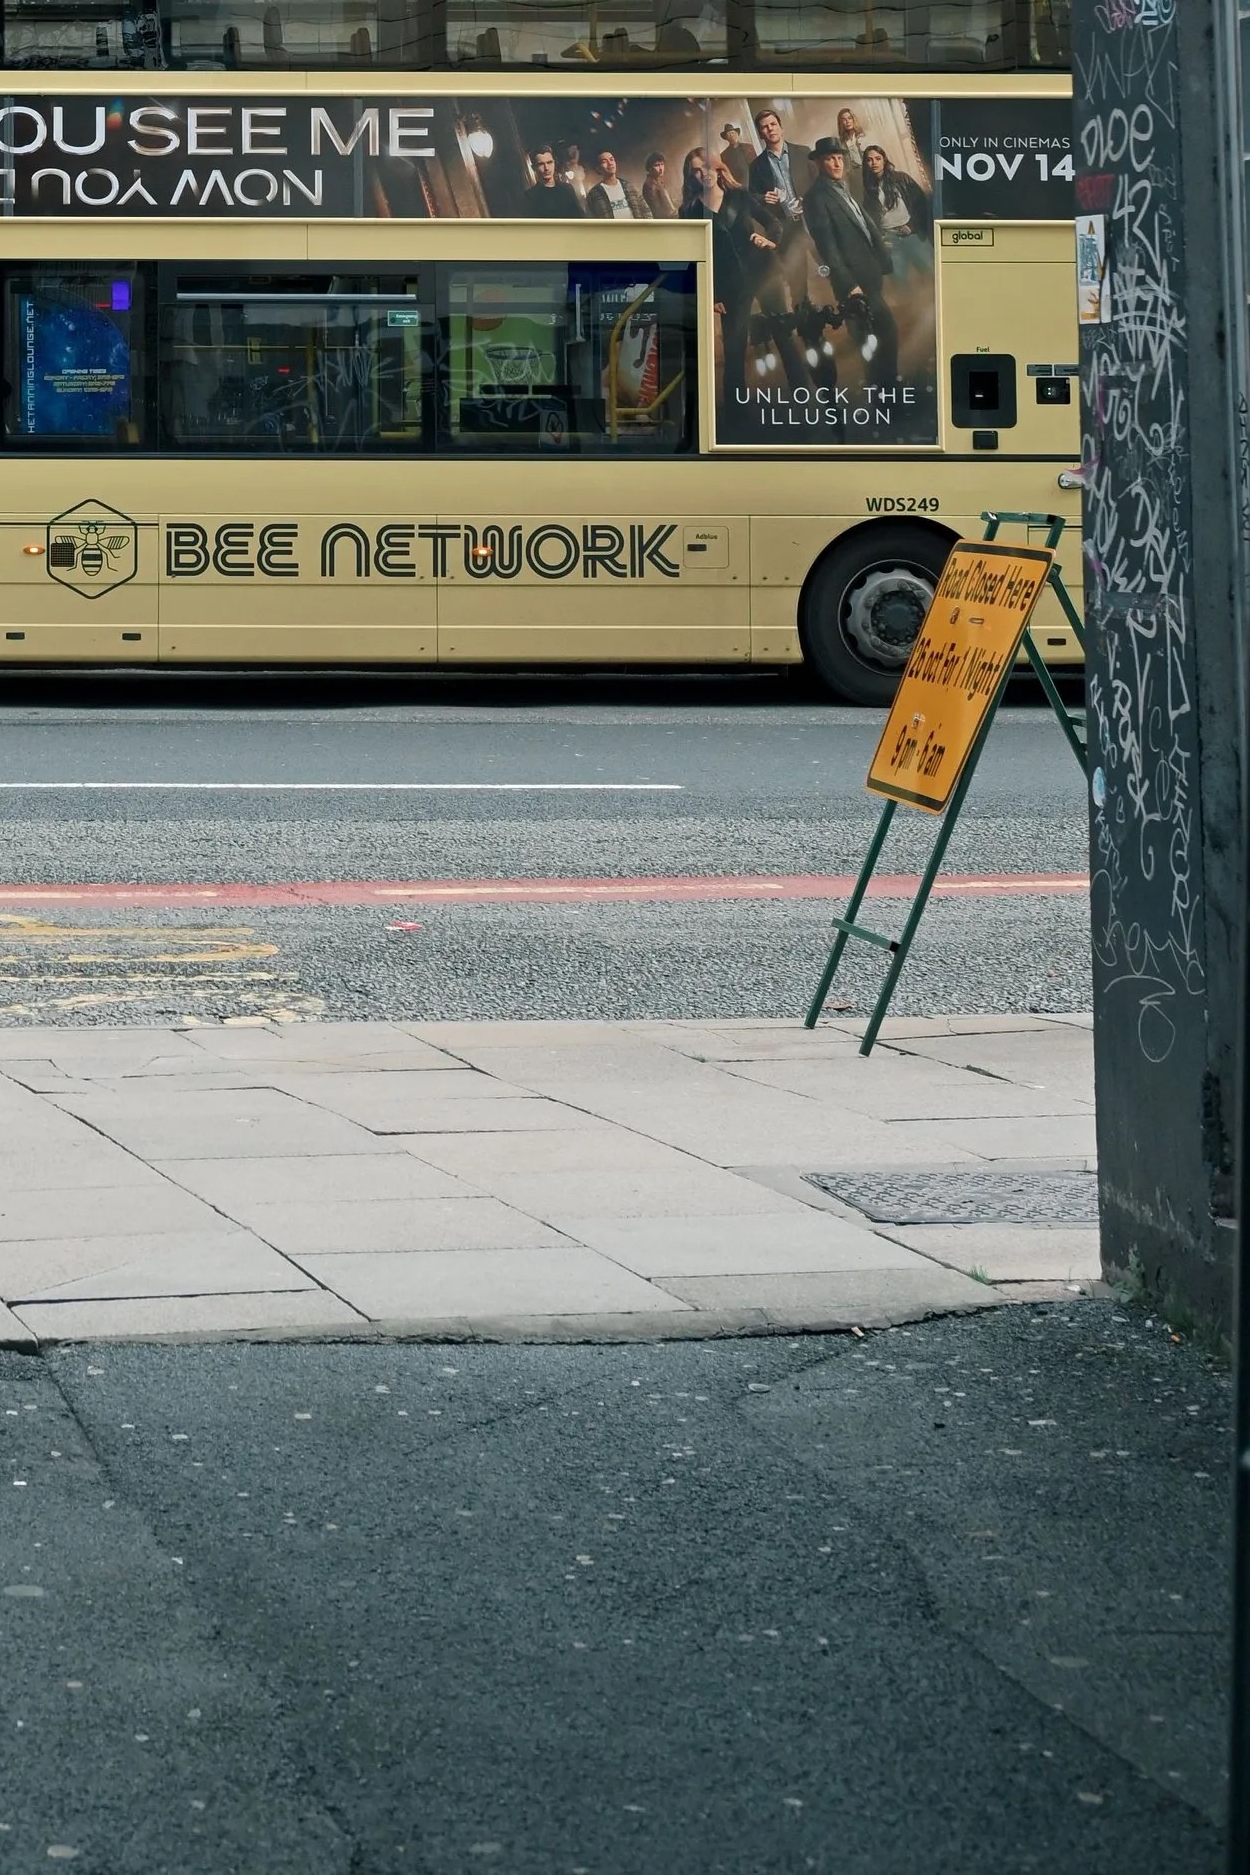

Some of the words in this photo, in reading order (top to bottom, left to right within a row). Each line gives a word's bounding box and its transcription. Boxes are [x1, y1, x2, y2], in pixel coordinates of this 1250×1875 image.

[127, 106, 288, 156] SEE
[310, 107, 436, 157] ME
[939, 136, 979, 148] ONLY
[984, 137, 998, 148] IN
[1003, 137, 1071, 149] CINEMAS
[31, 167, 158, 206] YOU
[169, 168, 323, 206] NOW
[934, 153, 1025, 182] NOV
[1035, 154, 1076, 182] 14
[952, 231, 983, 243] global
[735, 387, 849, 404] UNLOCK
[863, 387, 916, 404] THE
[761, 408, 891, 425] ILLUSION
[865, 497, 940, 512] WDS249
[166, 523, 298, 577] BEE
[321, 523, 680, 579] NETWORK
[938, 557, 974, 601] Road
[964, 559, 1006, 604] Closed
[999, 565, 1036, 611] Here
[908, 637, 931, 679] 26
[922, 642, 947, 684] oct
[937, 642, 960, 686] For
[953, 646, 971, 687] 1
[960, 647, 1004, 701] Night
